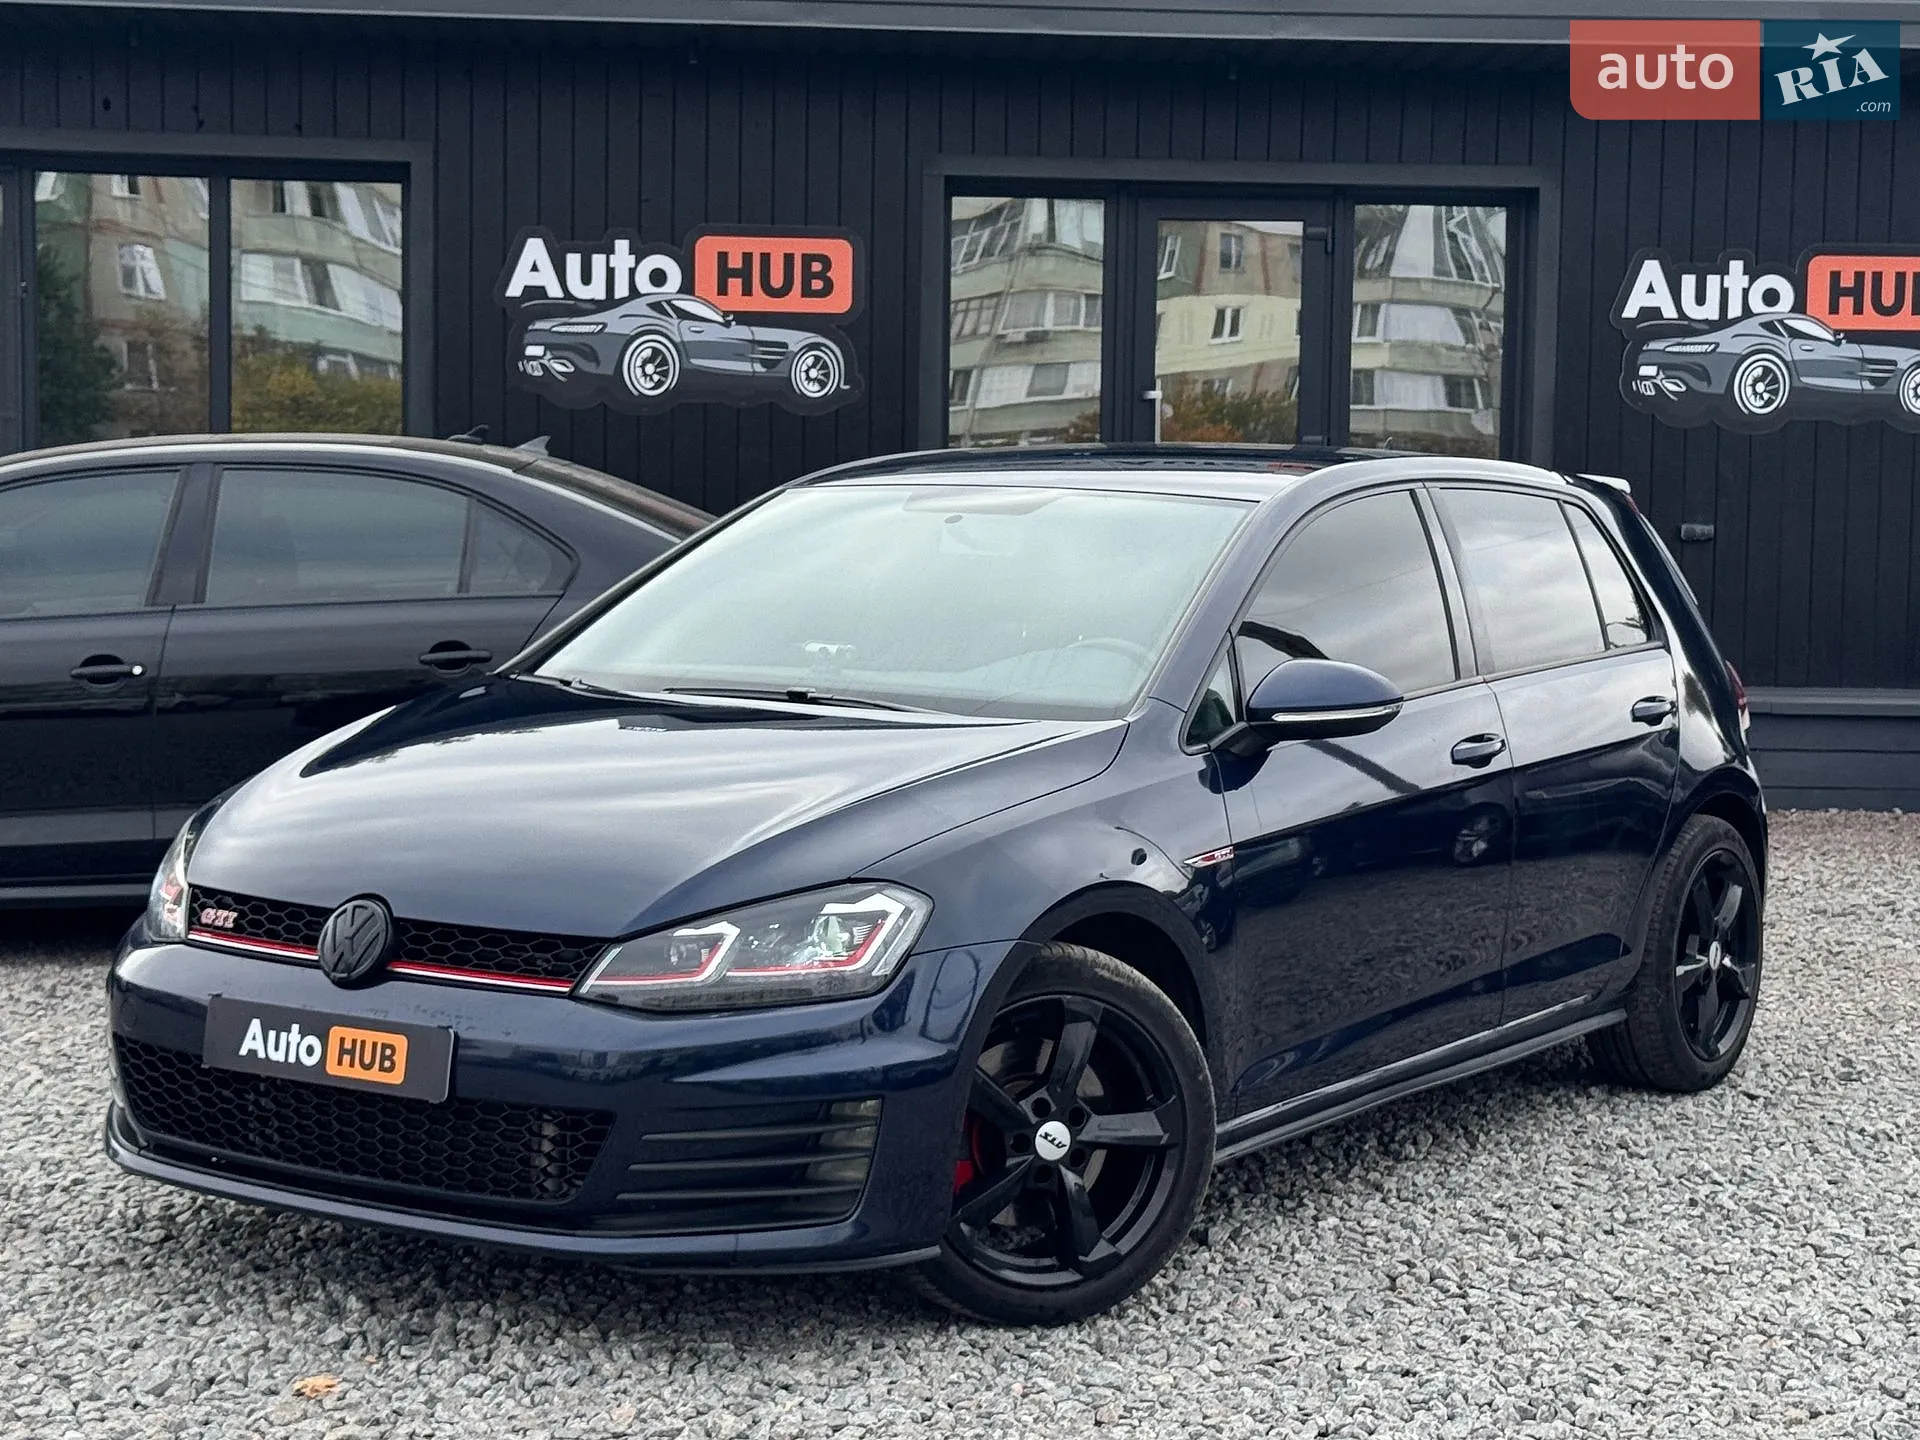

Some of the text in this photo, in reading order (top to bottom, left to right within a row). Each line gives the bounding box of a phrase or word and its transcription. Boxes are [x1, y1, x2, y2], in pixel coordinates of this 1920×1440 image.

[505, 237, 835, 300] Auto HUB
[1621, 259, 1920, 320] Auto HU
[200, 907, 239, 928] GTI
[238, 1017, 398, 1074] Auto HUB
